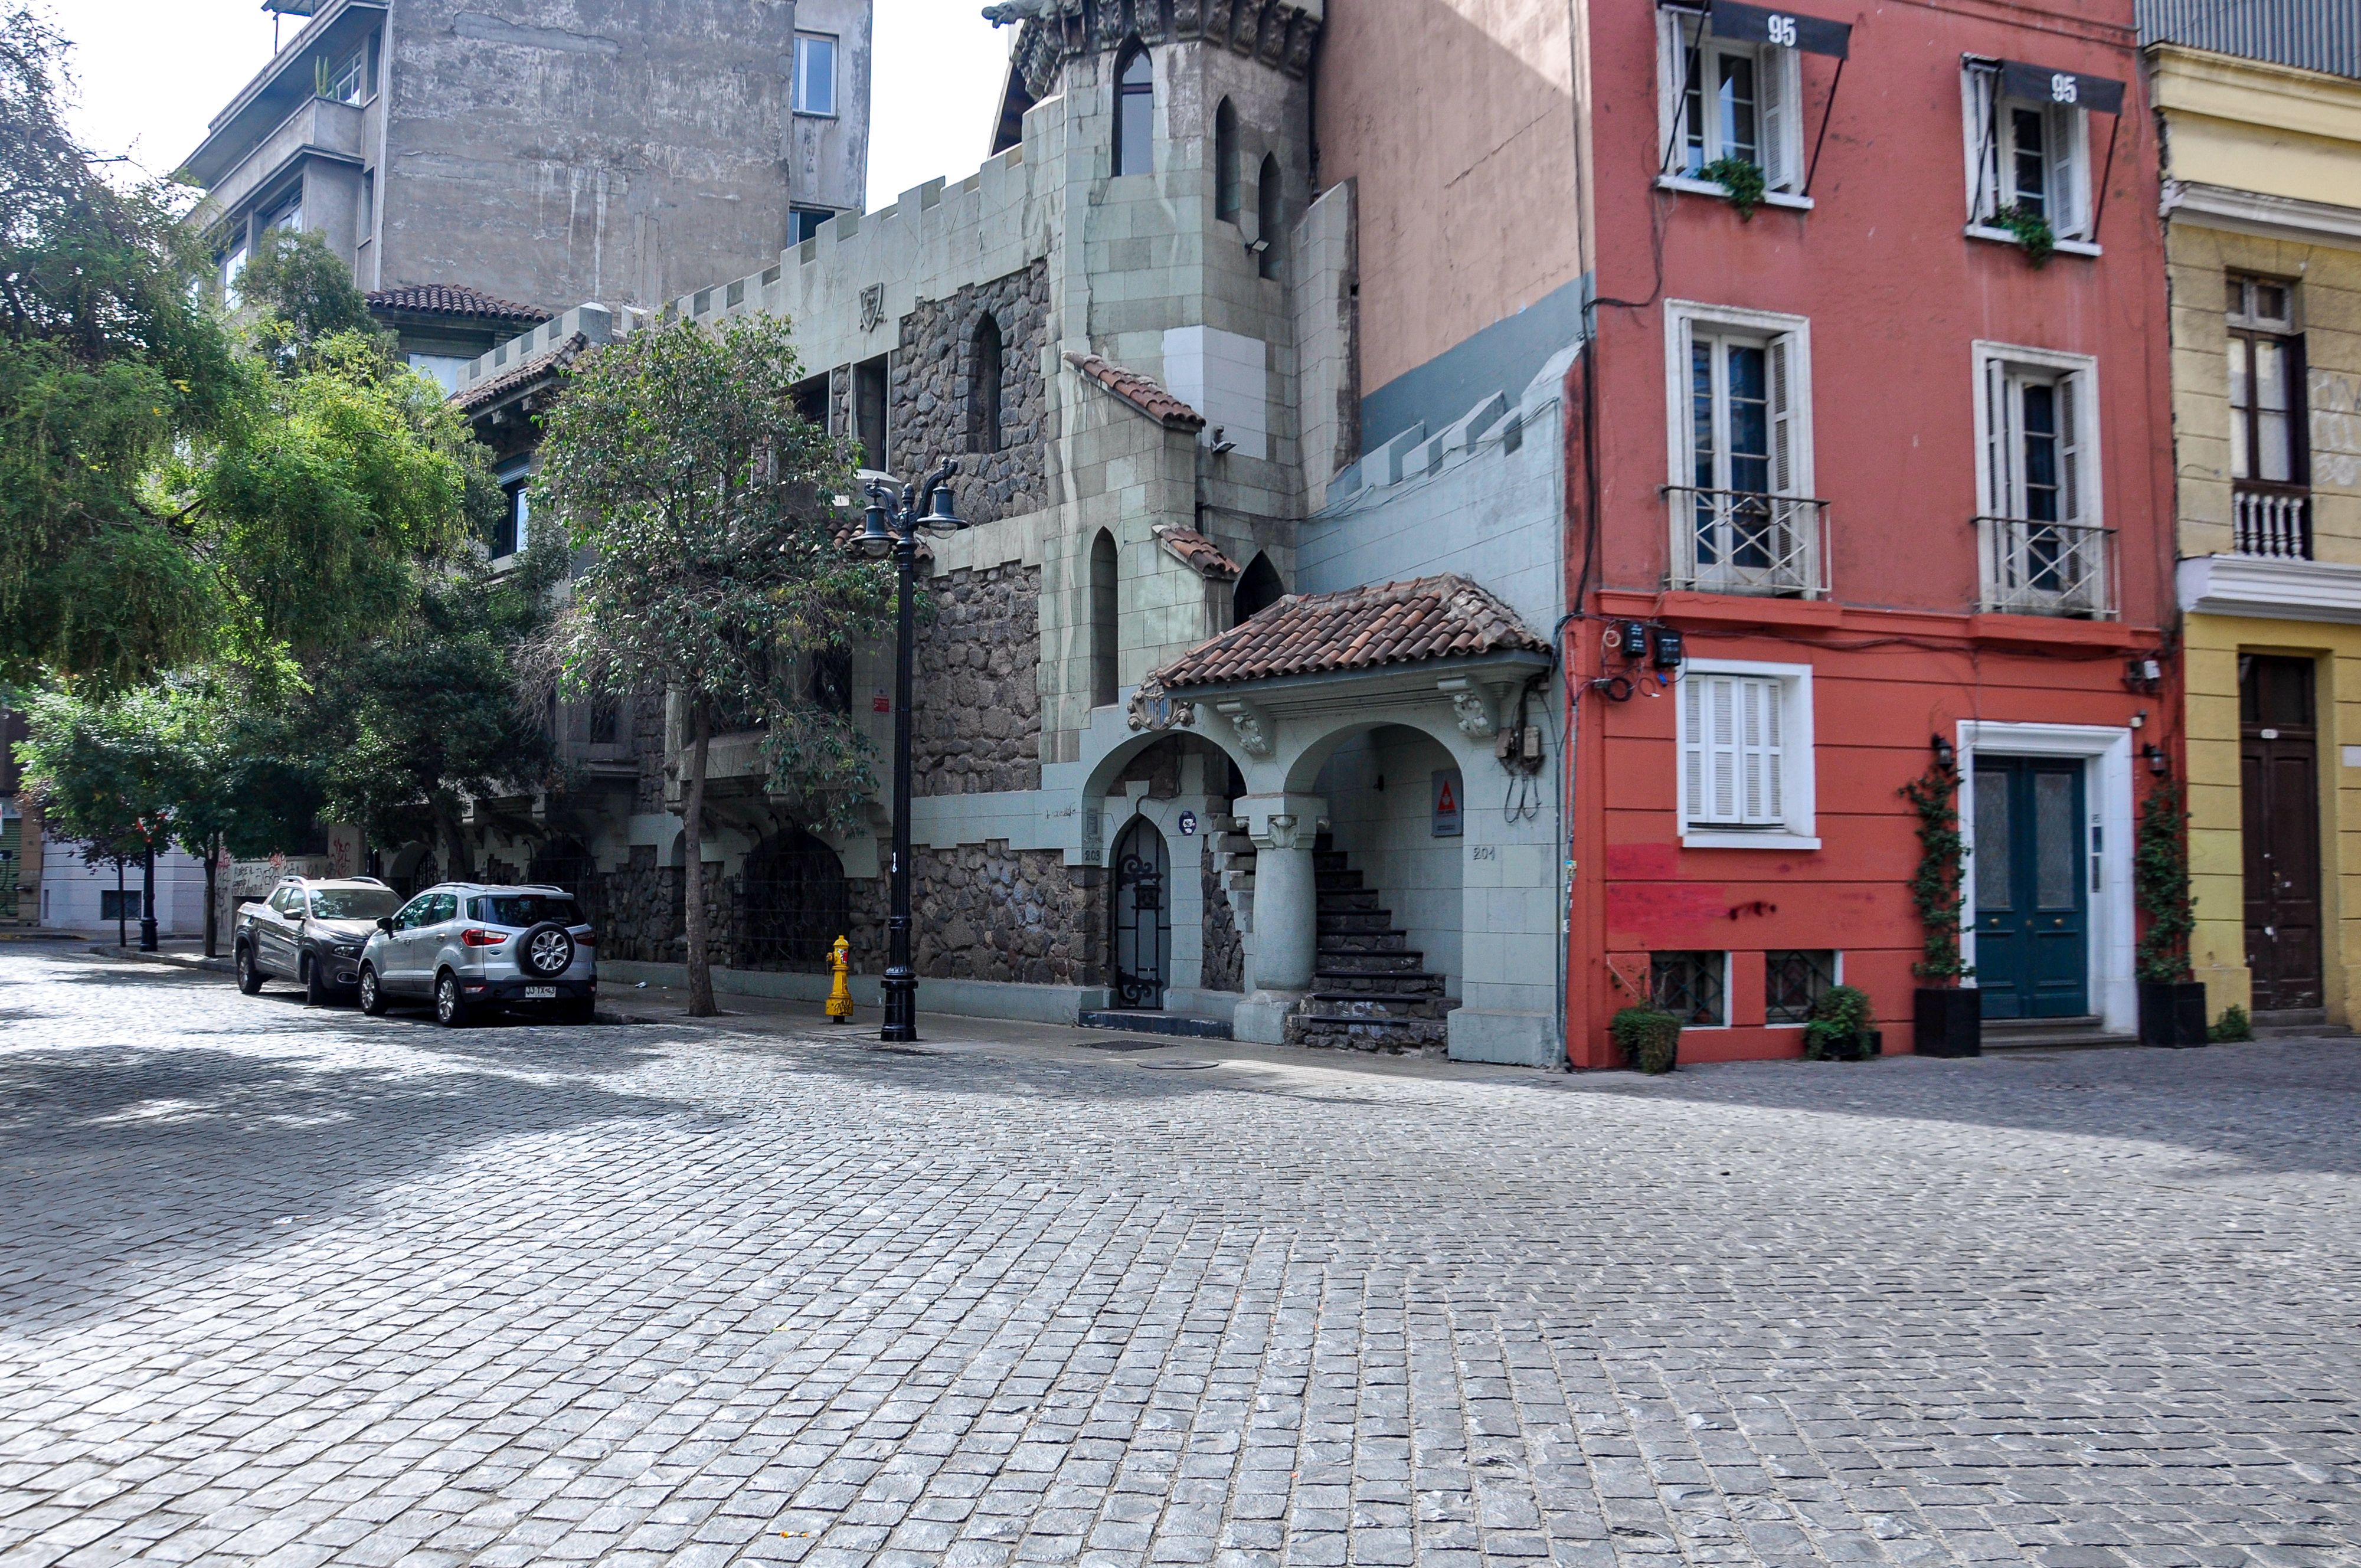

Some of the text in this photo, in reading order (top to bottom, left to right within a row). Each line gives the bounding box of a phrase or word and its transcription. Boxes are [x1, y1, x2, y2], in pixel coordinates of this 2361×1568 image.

[1768, 14, 1796, 47] 95
[2052, 73, 2077, 103] 95
[1085, 850, 1101, 861] 203
[1473, 846, 1495, 861] 201
